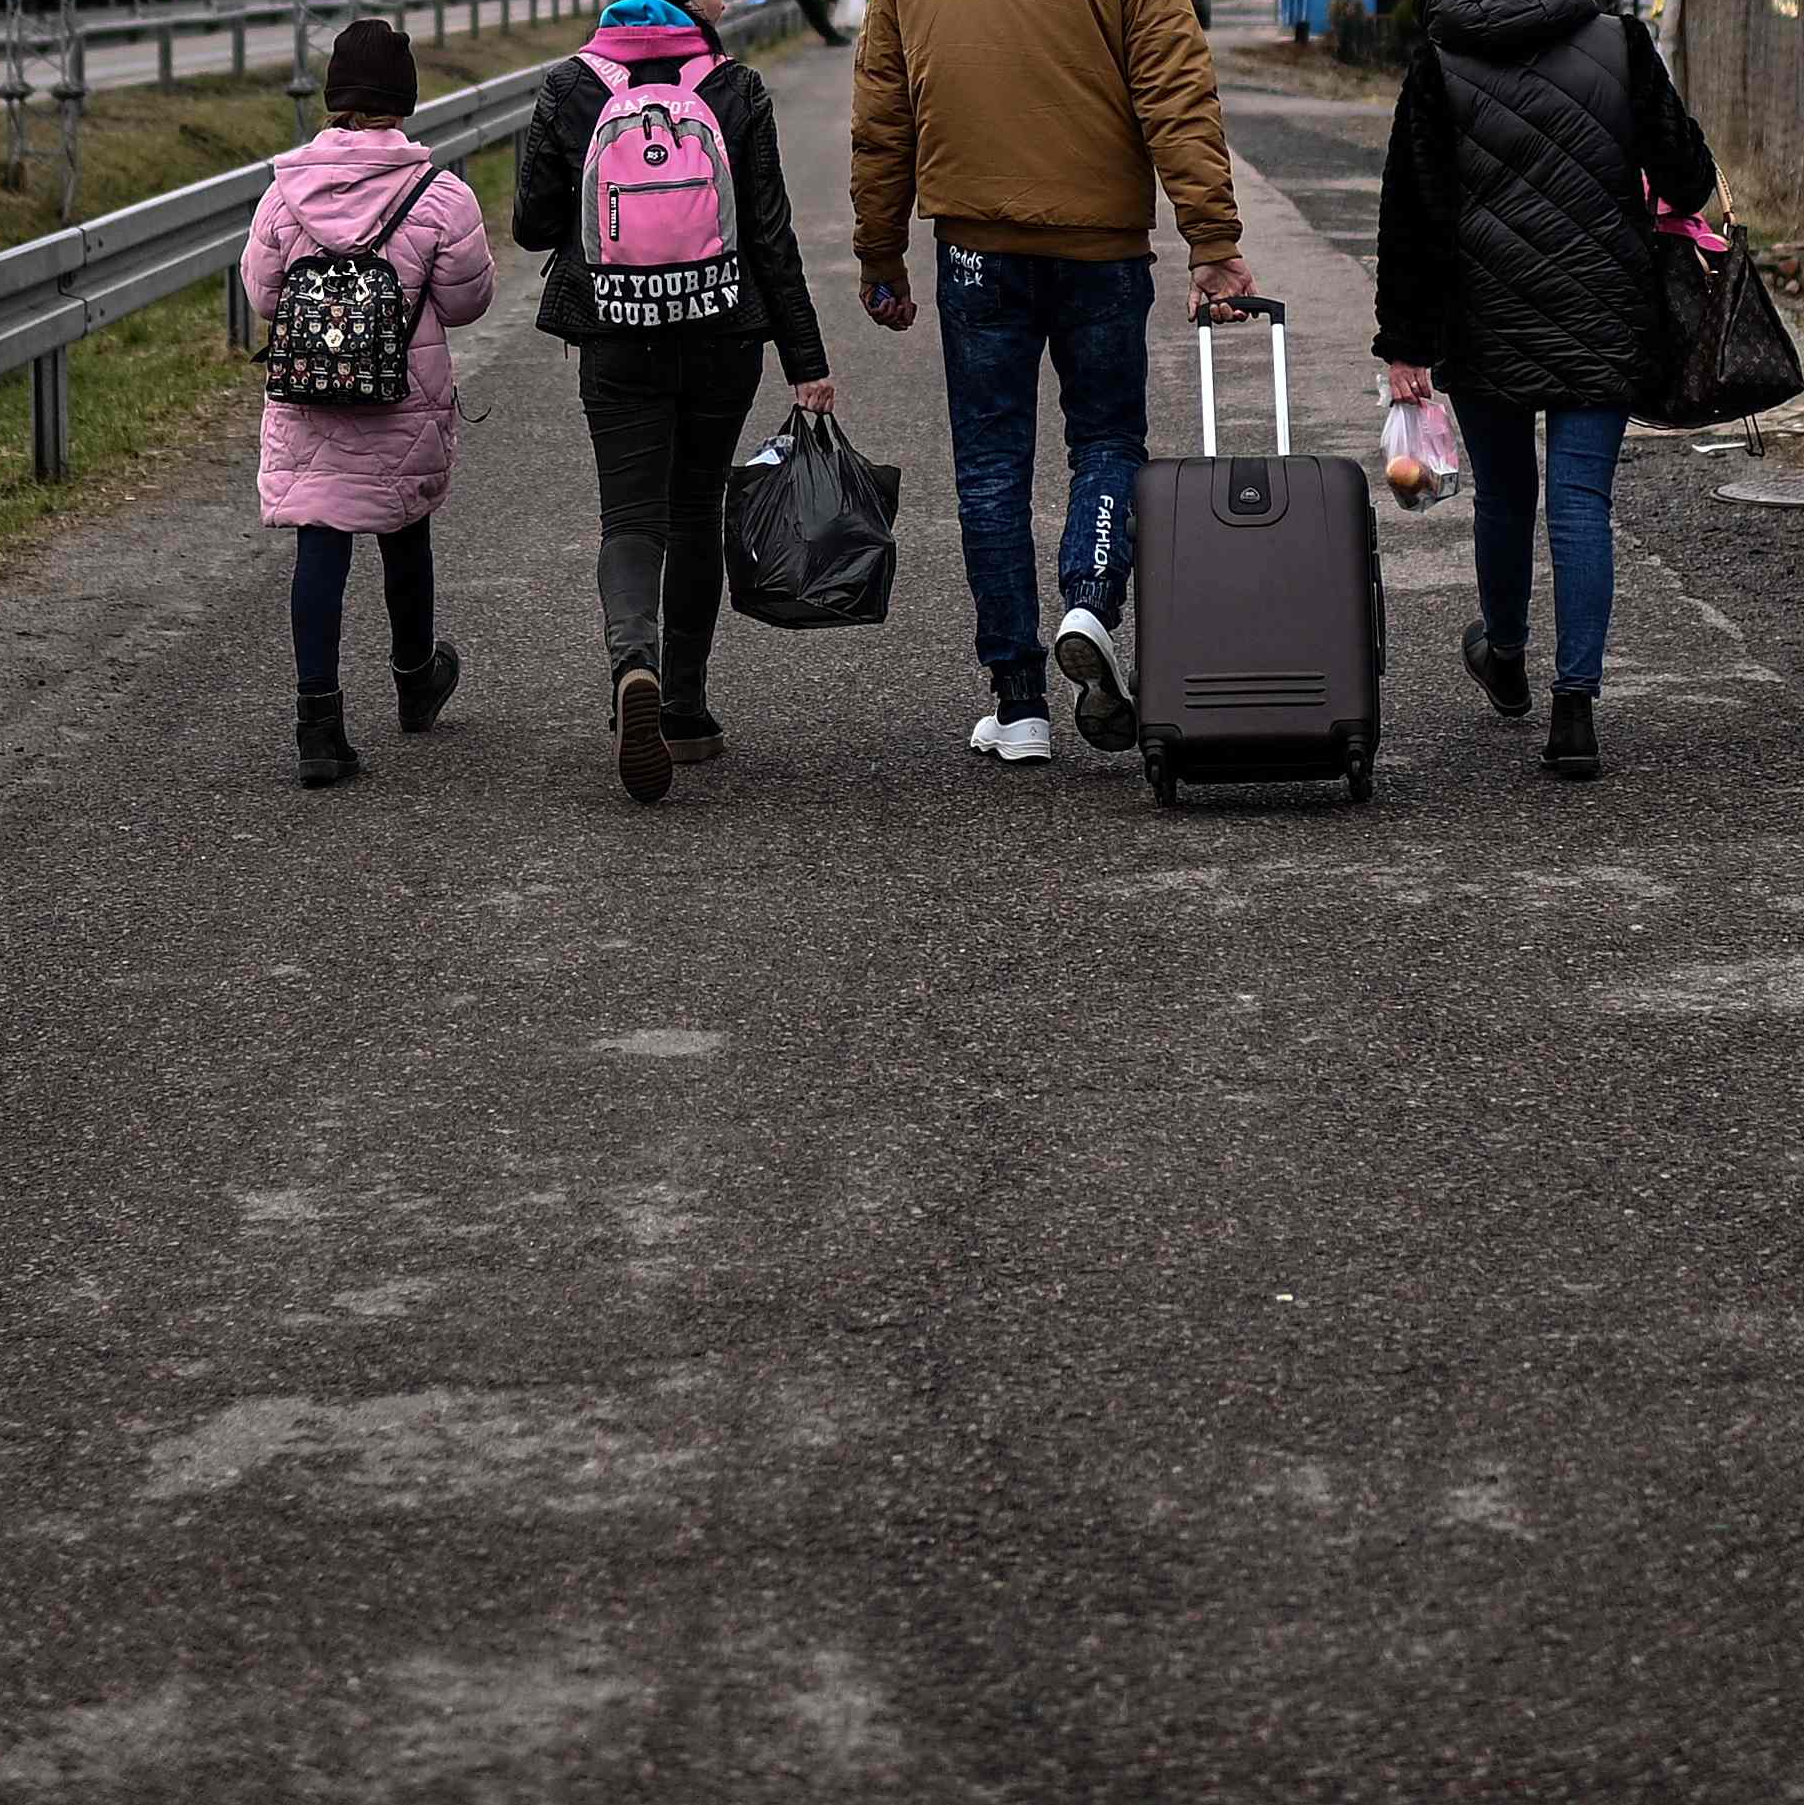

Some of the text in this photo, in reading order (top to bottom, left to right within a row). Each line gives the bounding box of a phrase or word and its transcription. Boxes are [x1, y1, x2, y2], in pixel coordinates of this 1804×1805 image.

[629, 271, 699, 298] YOUR
[595, 298, 661, 327] YOUR
[666, 291, 720, 324] BAE
[1094, 495, 1114, 579] FASHION
